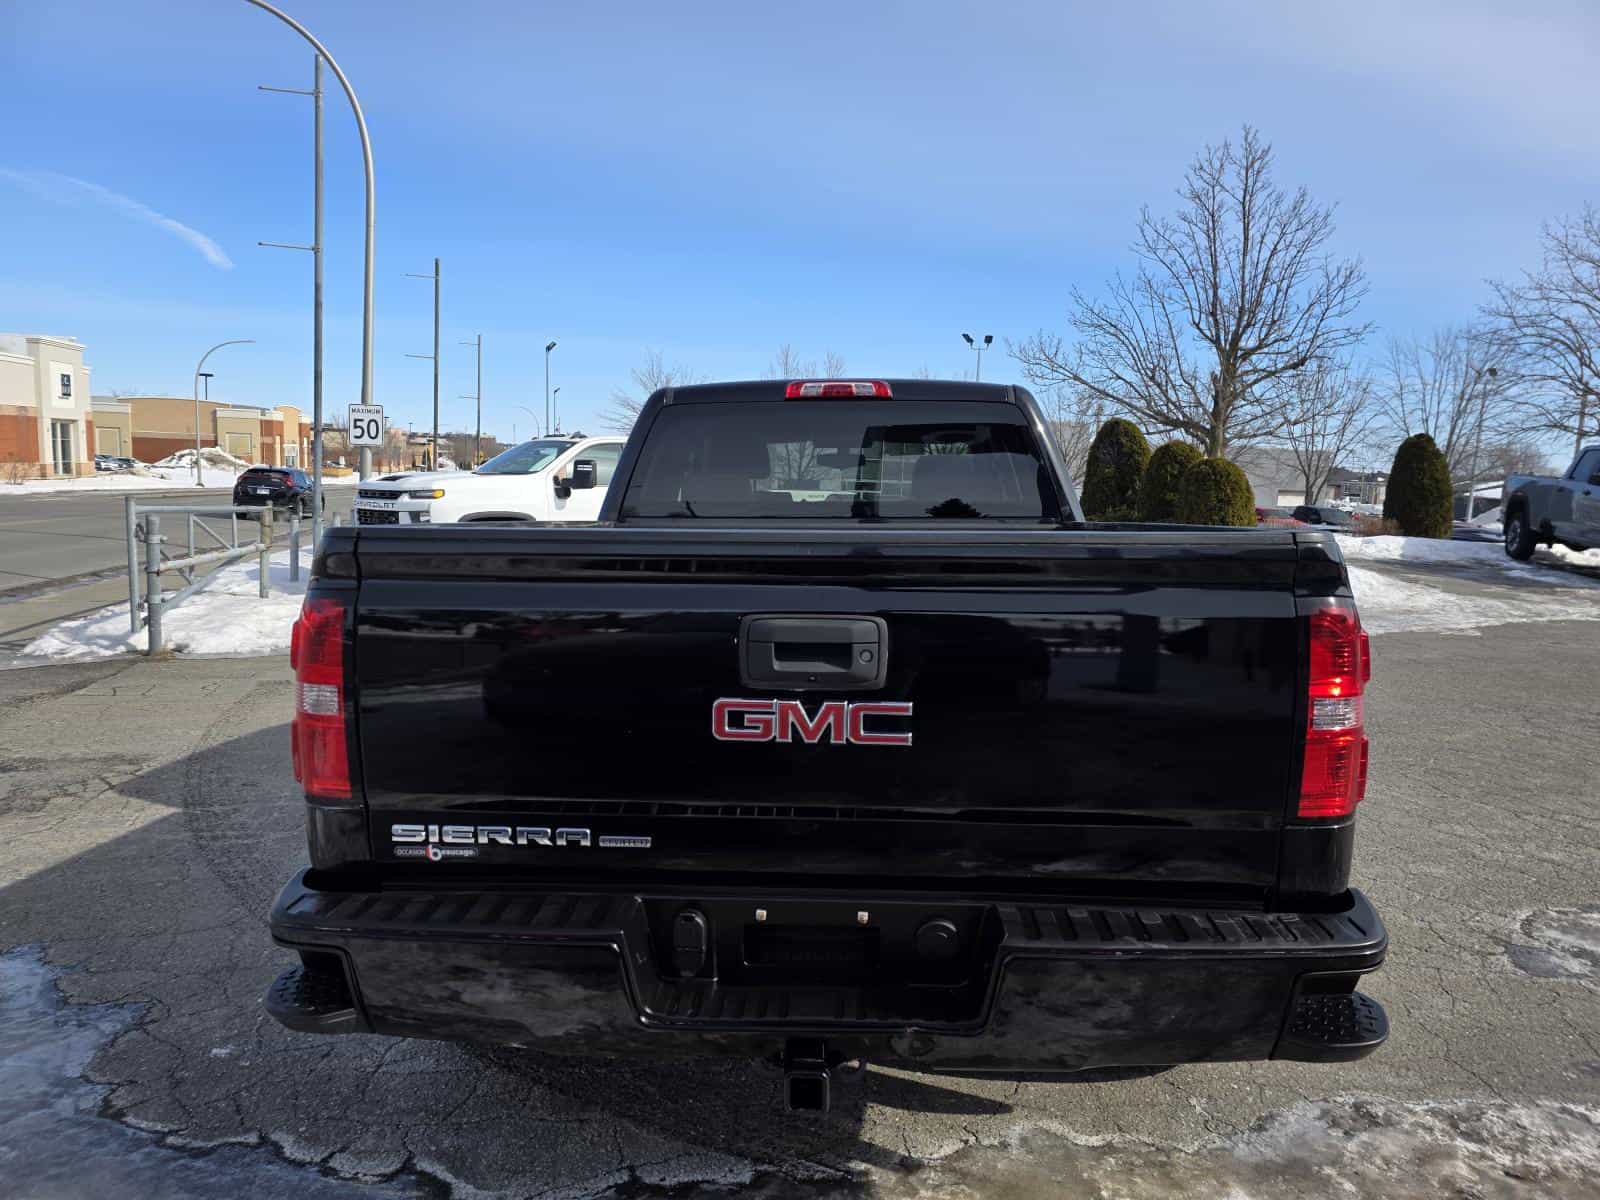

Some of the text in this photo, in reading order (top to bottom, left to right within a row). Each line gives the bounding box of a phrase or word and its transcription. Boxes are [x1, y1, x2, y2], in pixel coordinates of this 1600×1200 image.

[353, 418, 379, 440] 50
[712, 697, 913, 746] GMC
[391, 824, 591, 847] SIERRA
